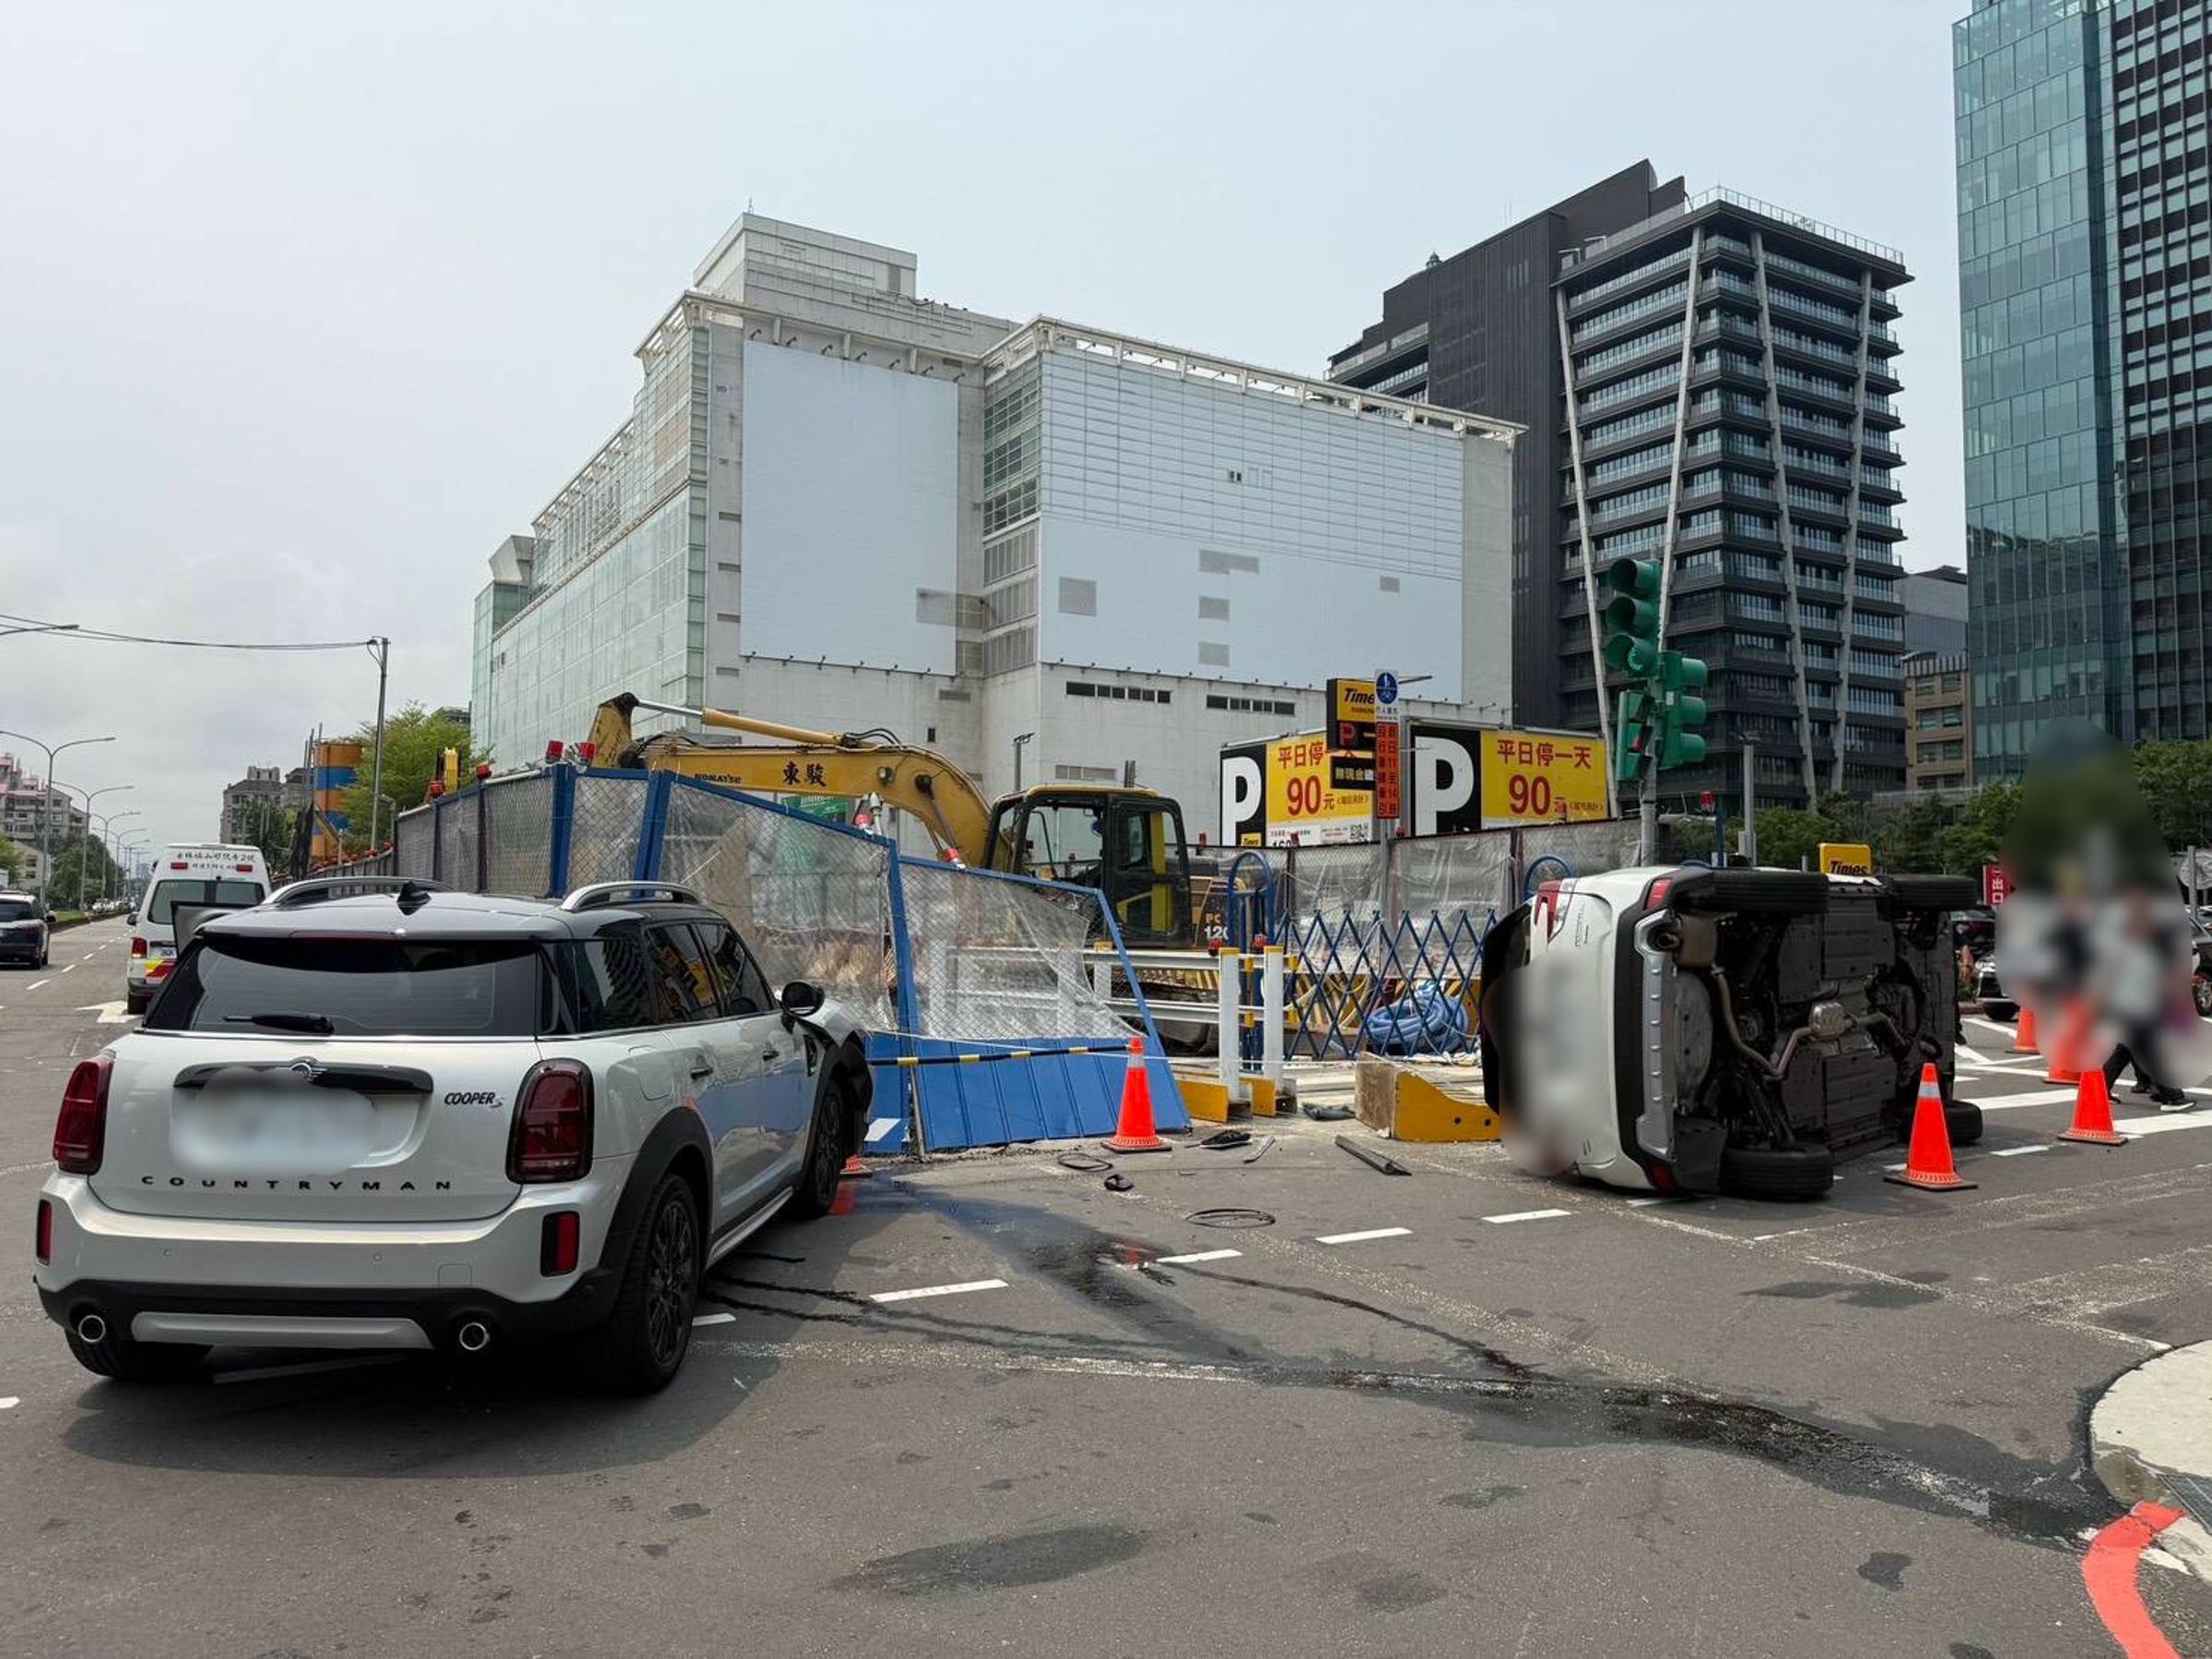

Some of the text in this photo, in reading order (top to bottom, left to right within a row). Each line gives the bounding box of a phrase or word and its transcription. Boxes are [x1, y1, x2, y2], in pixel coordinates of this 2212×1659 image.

[1344, 688, 1375, 704] Time
[1278, 741, 1328, 770] 平日停
[1498, 739, 1591, 769] 平日停一天
[783, 760, 827, 786] 東駿
[1415, 736, 1474, 836] P
[1222, 757, 1261, 845] P
[1830, 860, 1869, 877] Times
[444, 1092, 496, 1105] COOPER
[141, 1176, 451, 1191] COUNTRYMAN
